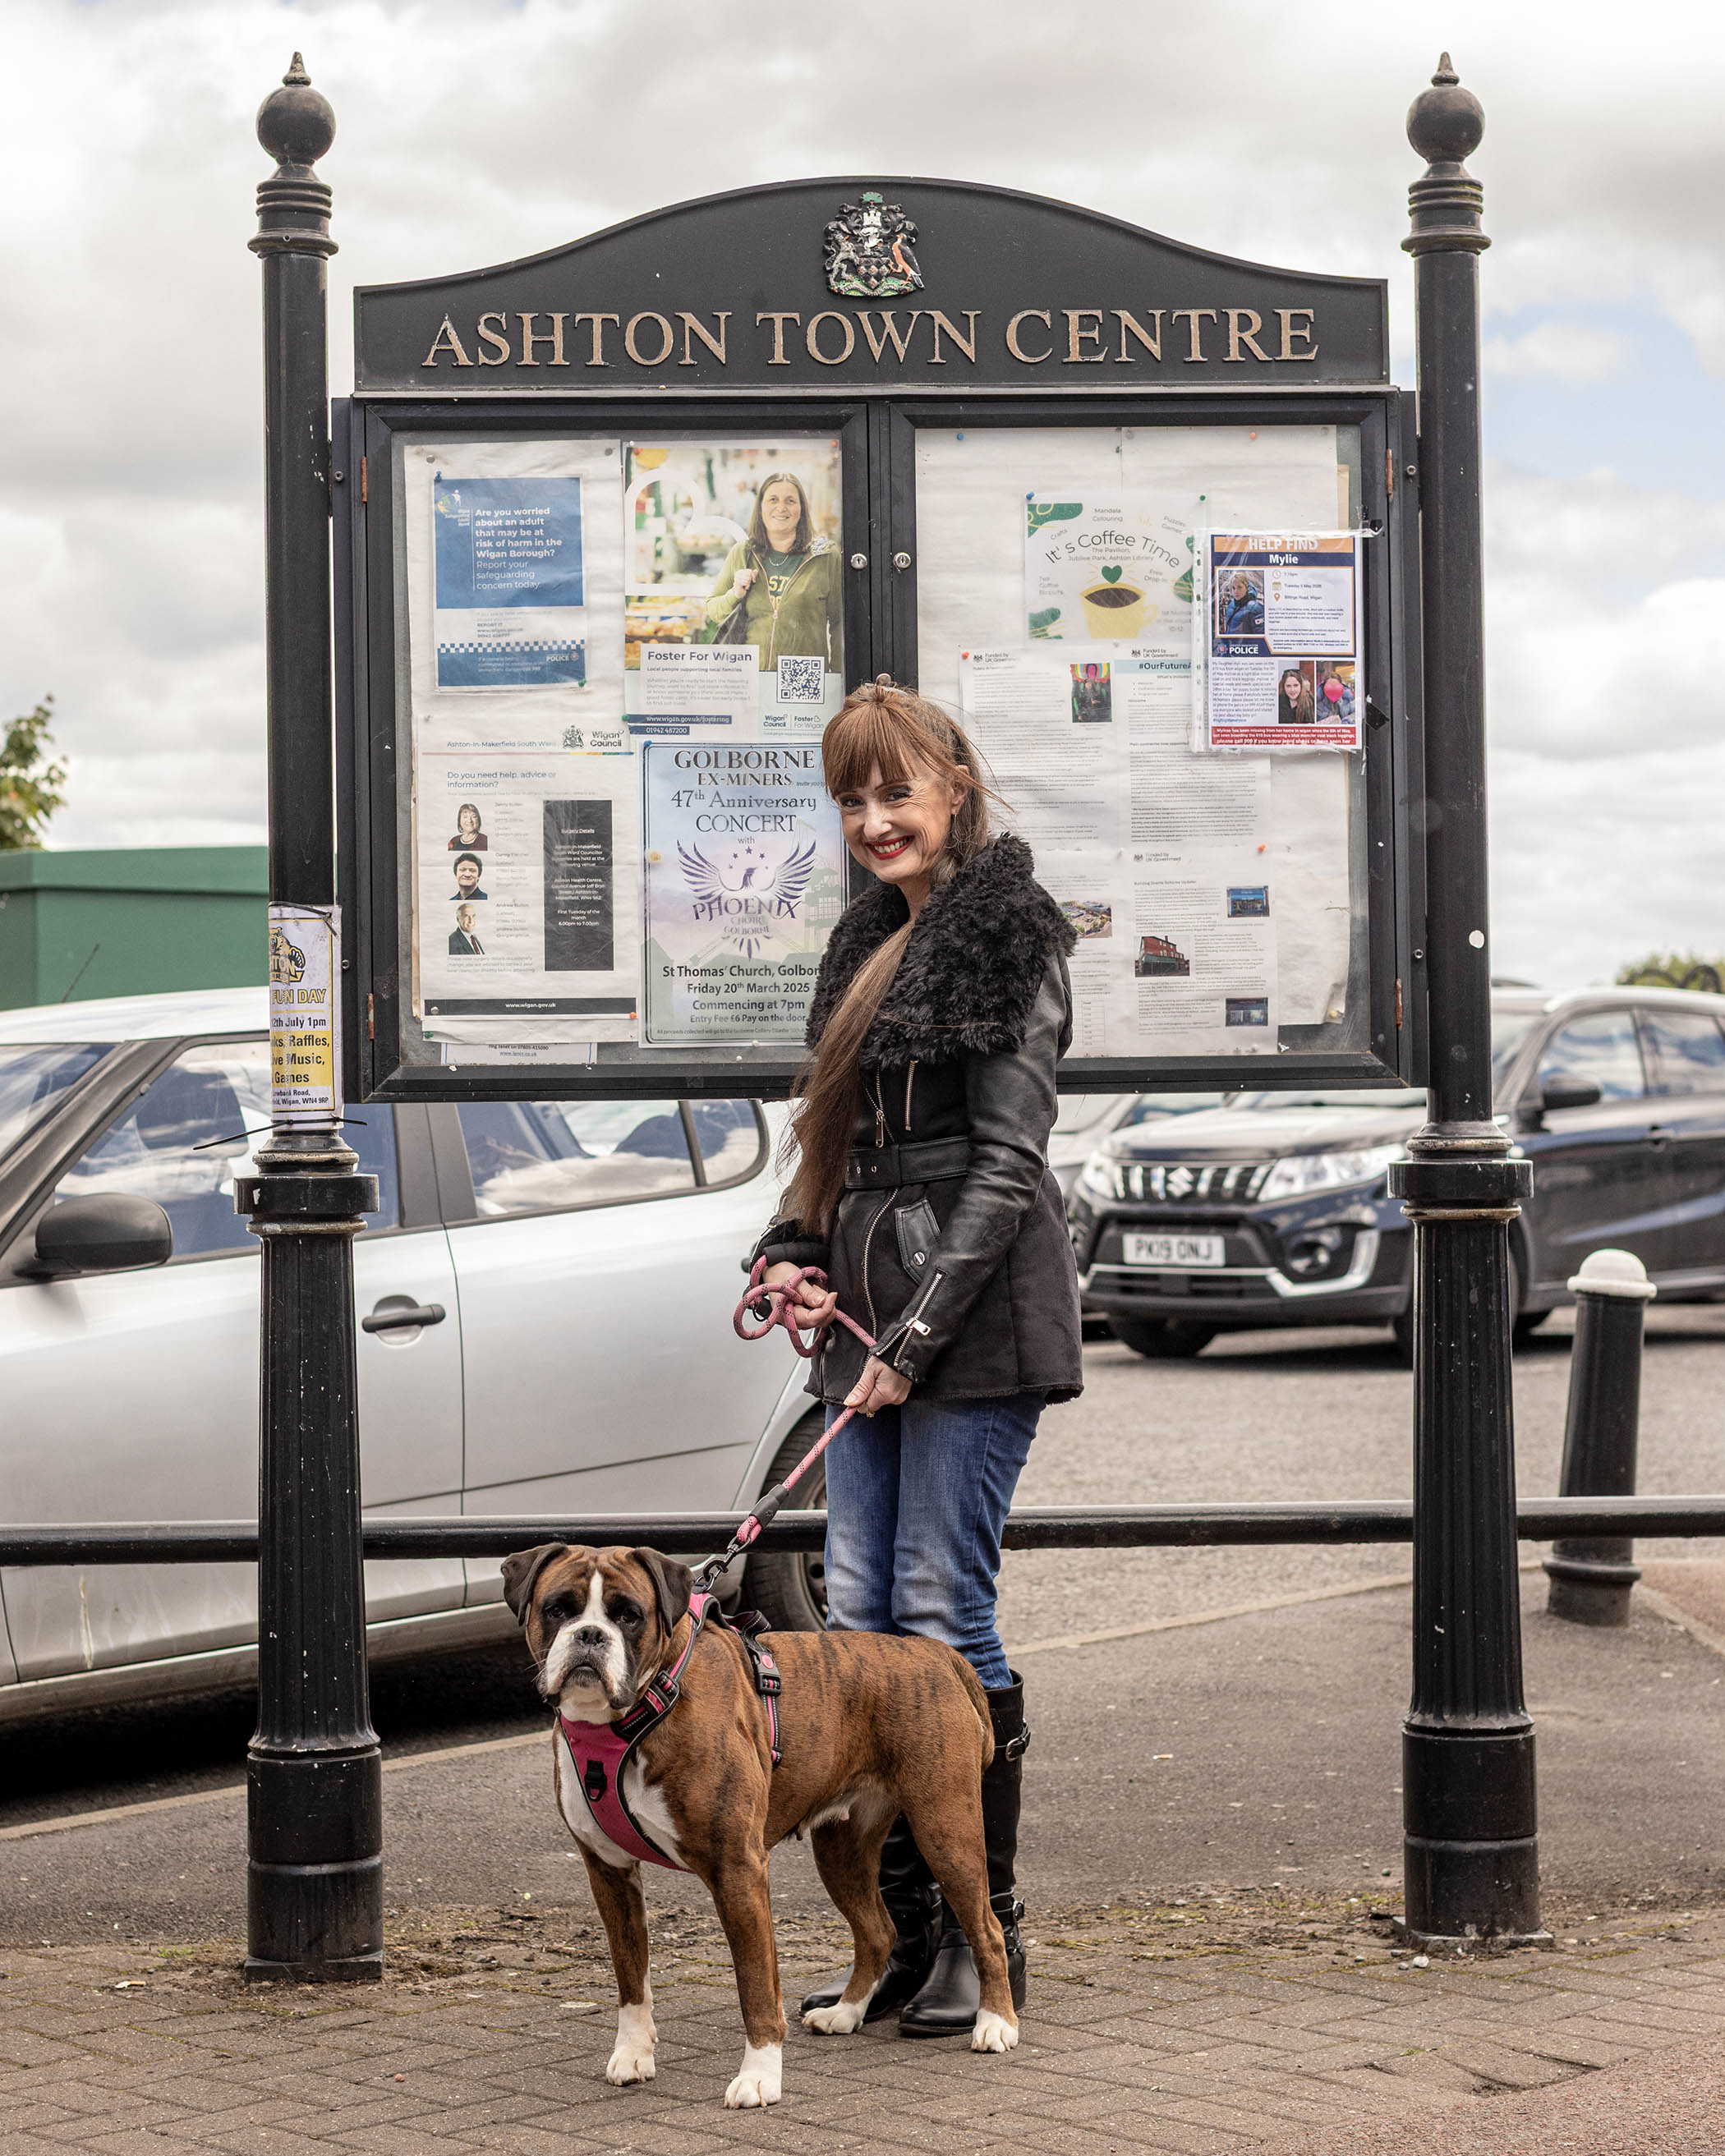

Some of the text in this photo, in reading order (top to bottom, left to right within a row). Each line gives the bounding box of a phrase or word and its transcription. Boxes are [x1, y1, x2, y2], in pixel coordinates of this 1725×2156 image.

[421, 308, 1318, 366] ASHTON TOWN CENTRE
[475, 507, 550, 517] Are you worried
[476, 518, 503, 526] about
[519, 517, 545, 526] adult
[476, 528, 544, 538] that may be at
[1051, 528, 1068, 540] Crafts
[476, 538, 563, 547] risk of harm in the
[1249, 538, 1318, 551] HELP FIND
[476, 549, 555, 559] Wigan Borough?
[1078, 530, 1135, 548] Coffee
[1143, 536, 1180, 568] Time
[476, 560, 528, 570] Report your
[1269, 554, 1299, 566] Mylie
[476, 571, 535, 581] safeguarding
[476, 582, 513, 590] concern
[647, 651, 752, 663] Foster For Wigan
[592, 730, 620, 740] Wigan
[590, 739, 622, 747] Council
[674, 750, 816, 770] GOLBORNE
[448, 771, 458, 779] Do
[461, 773, 475, 781] you
[477, 771, 498, 779] need
[520, 771, 546, 779] advice
[697, 772, 793, 786] EX-MINERS
[670, 789, 816, 811] 47th Anniversary
[696, 814, 797, 833] CONCERT
[738, 836, 755, 844] with
[692, 894, 802, 921] PHOENIX
[663, 966, 674, 977] St
[729, 964, 775, 978] Church,
[778, 964, 821, 976] Golborn
[688, 982, 810, 995] Friday 20th March 2025
[273, 989, 326, 1004] FUN DAY
[692, 1000, 805, 1012] Commencing at 7pm
[285, 1017, 305, 1028] July
[307, 1018, 326, 1028] 1pm
[690, 1015, 711, 1024] Entry
[742, 1014, 757, 1023] Pay
[289, 1035, 329, 1047] Raffles,
[286, 1053, 325, 1065] Music,
[274, 1071, 310, 1083] Games
